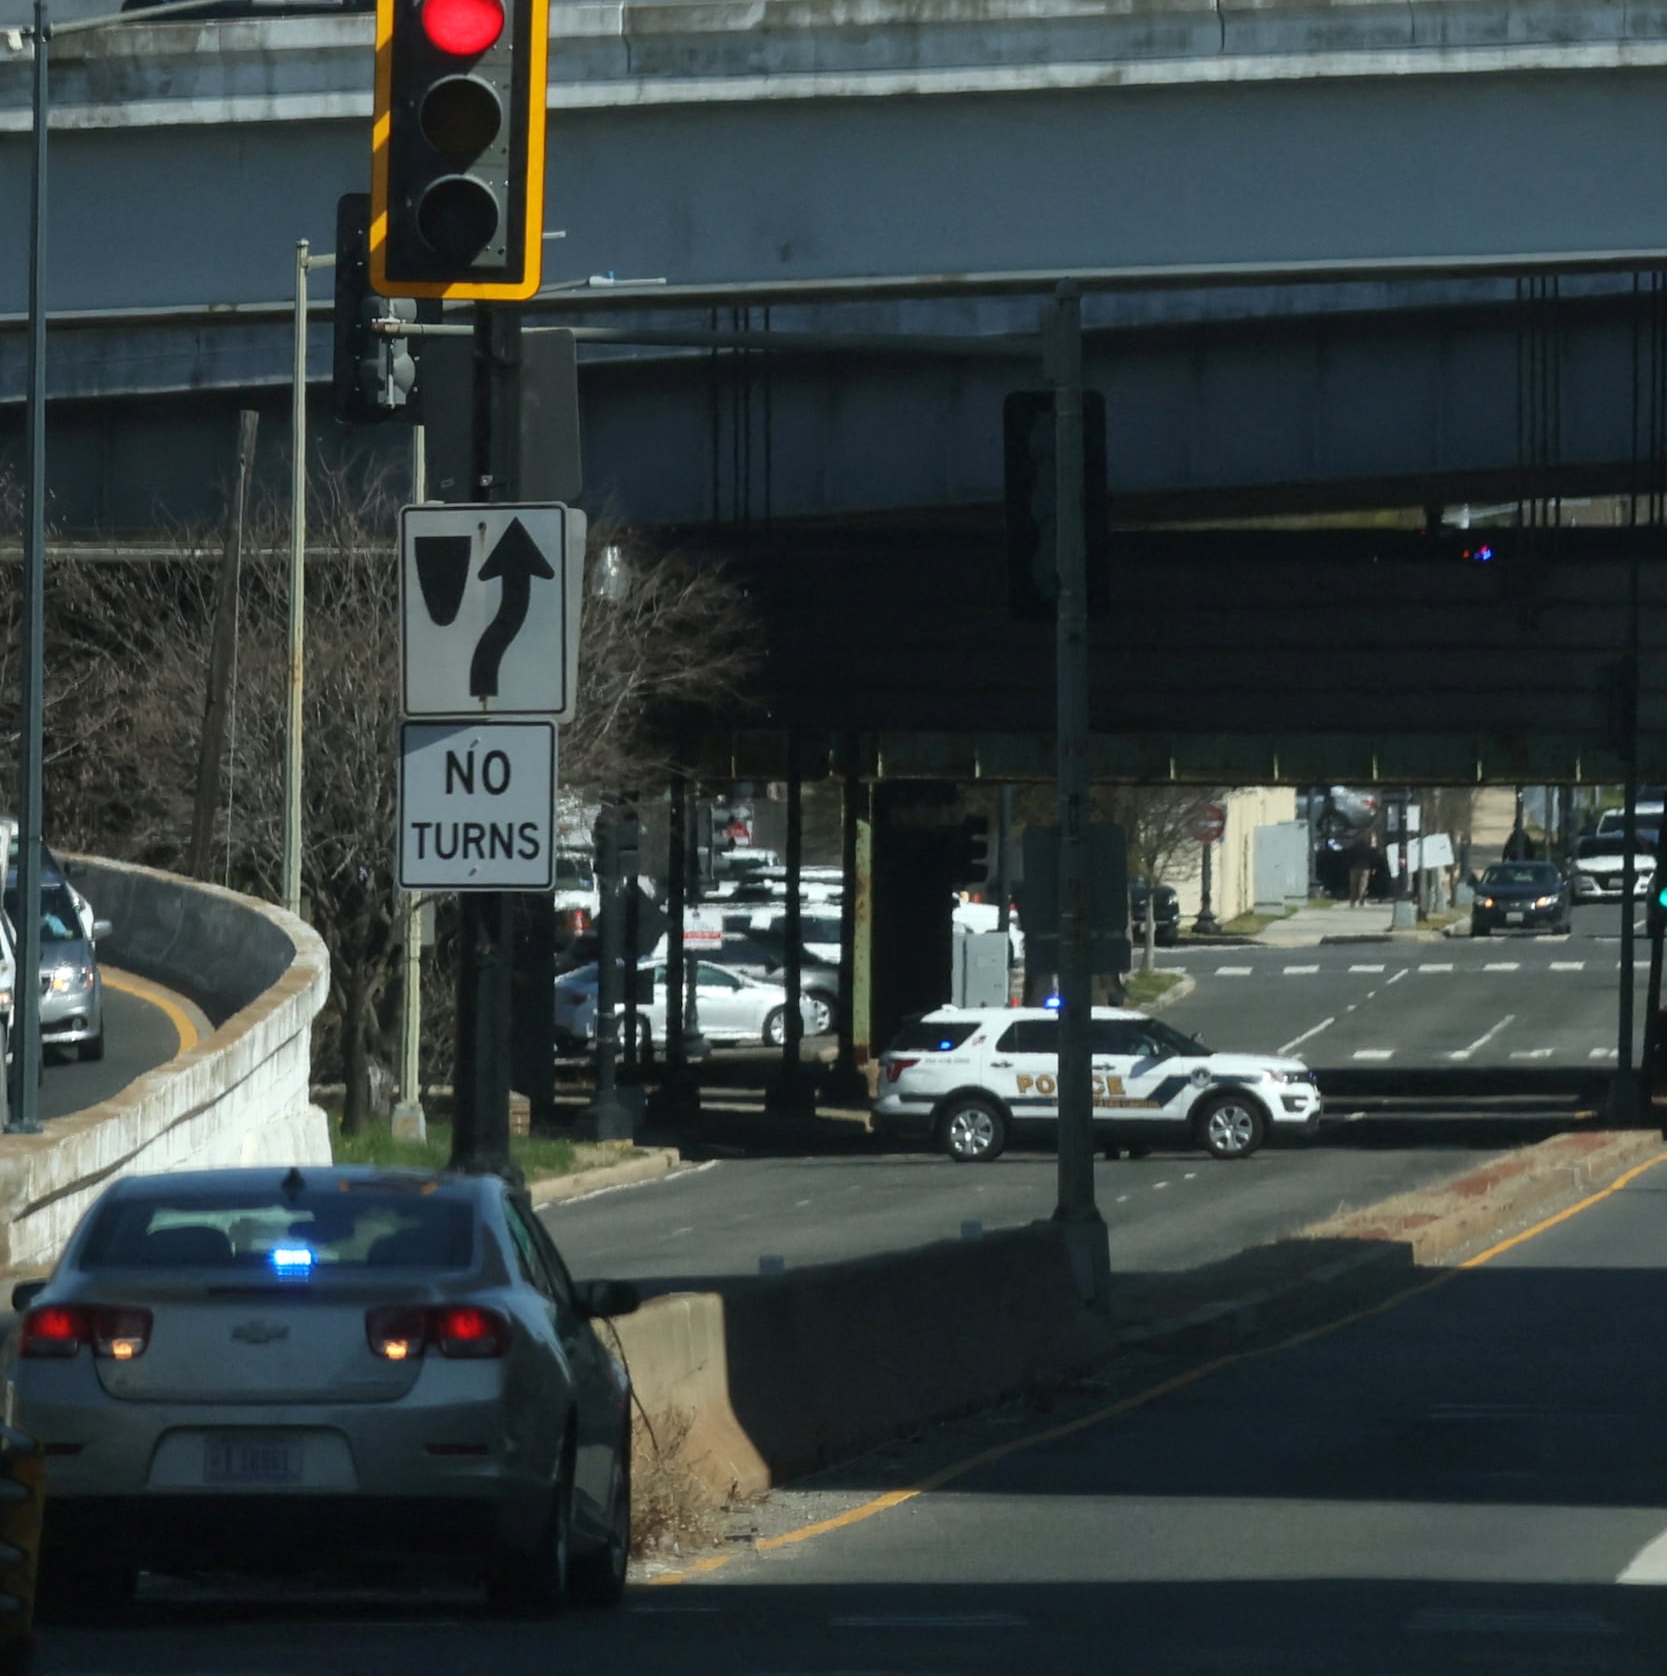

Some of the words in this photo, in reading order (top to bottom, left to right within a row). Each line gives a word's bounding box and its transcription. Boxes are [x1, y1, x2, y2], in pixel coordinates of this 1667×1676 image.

[445, 750, 511, 795] NO
[411, 821, 541, 861] TURNS
[1016, 1074, 1126, 1096] POCE
